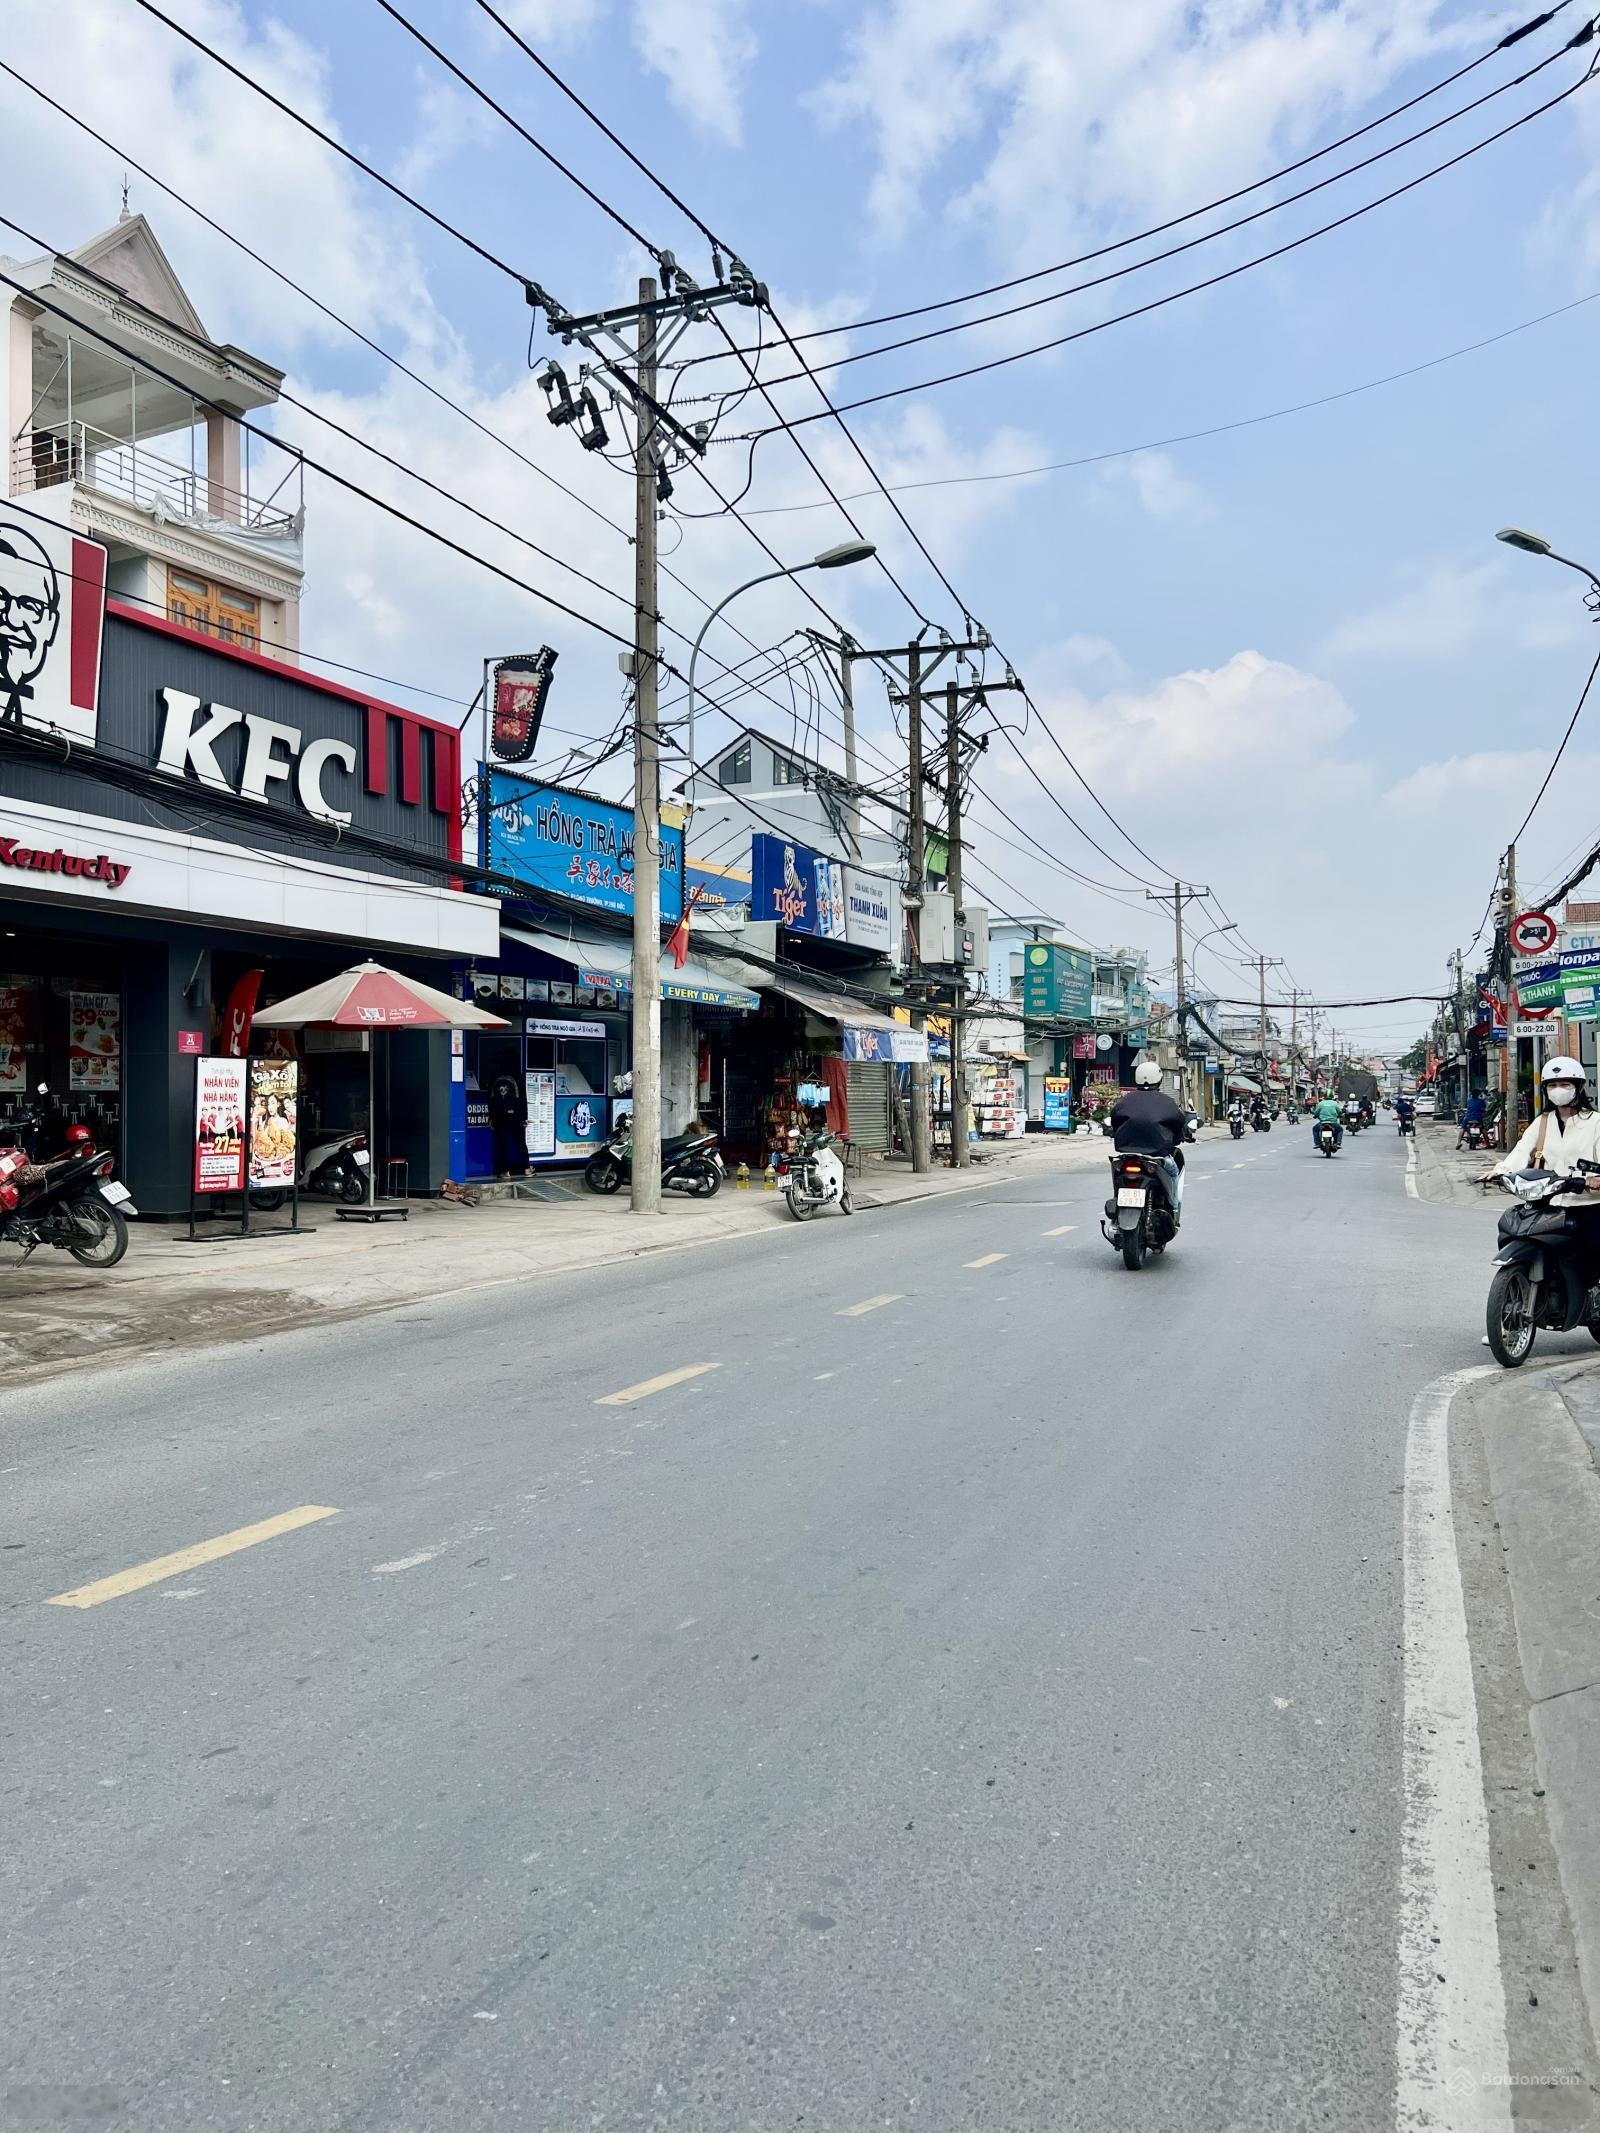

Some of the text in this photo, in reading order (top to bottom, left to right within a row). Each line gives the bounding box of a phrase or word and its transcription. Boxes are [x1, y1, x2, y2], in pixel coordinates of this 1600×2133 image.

[156, 686, 357, 828] KFC
[536, 798, 584, 849] HỒNG
[587, 818, 618, 858] TRÀ
[0, 836, 132, 888] Kentucky
[773, 888, 807, 925] Tiger
[850, 896, 871, 916] THANH
[872, 901, 888, 921] XUÂN
[1571, 936, 1594, 949] CTY
[584, 973, 612, 987] MUA
[615, 978, 623, 988] 5
[668, 987, 699, 1000] EVERY
[701, 991, 720, 1003] DAY
[1527, 985, 1556, 1001] THÀNH
[204, 1076, 239, 1088] NHÂN VIÊN
[203, 1092, 238, 1103] NHÀ HÀNG
[467, 1104, 489, 1113] ORDER
[467, 1116, 489, 1124] TẠI ĐÂY
[214, 1136, 230, 1154] 27
